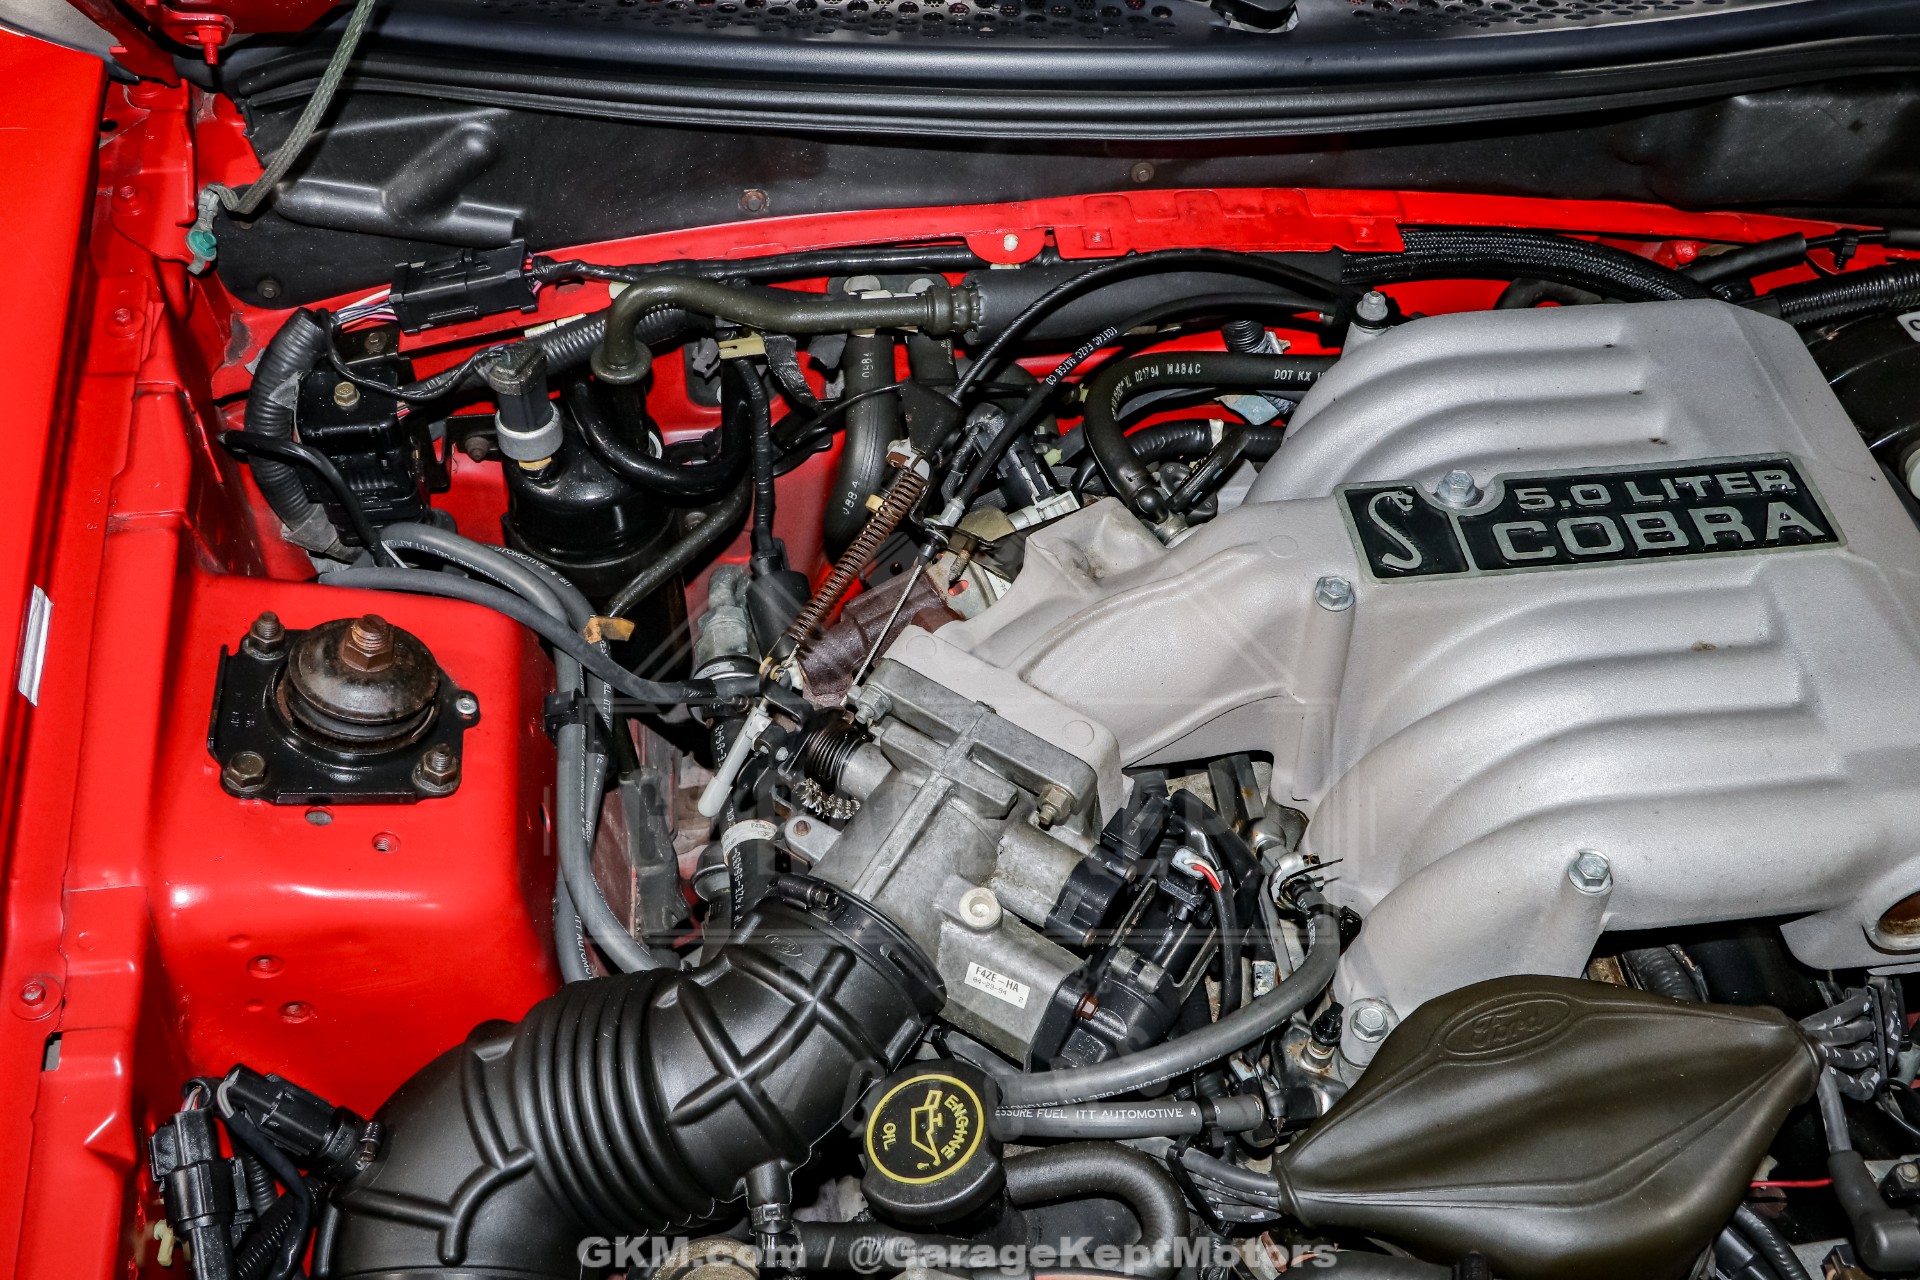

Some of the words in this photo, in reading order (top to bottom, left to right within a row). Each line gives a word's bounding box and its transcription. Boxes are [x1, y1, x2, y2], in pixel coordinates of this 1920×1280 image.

[1273, 368, 1294, 381] DOT
[1297, 370, 1312, 382] KX
[1514, 483, 1612, 511] 5.0
[1624, 469, 1797, 504] LITER
[1491, 501, 1827, 561] COBRA
[1471, 1005, 1547, 1050] Ford
[940, 1094, 970, 1161] ENGINE
[1036, 1108, 1068, 1119] FUEL
[1076, 1108, 1097, 1119] ITT
[1101, 1107, 1184, 1119] AUTOMOTIVE
[1190, 1107, 1197, 1117] 4
[882, 1122, 897, 1151] OIL
